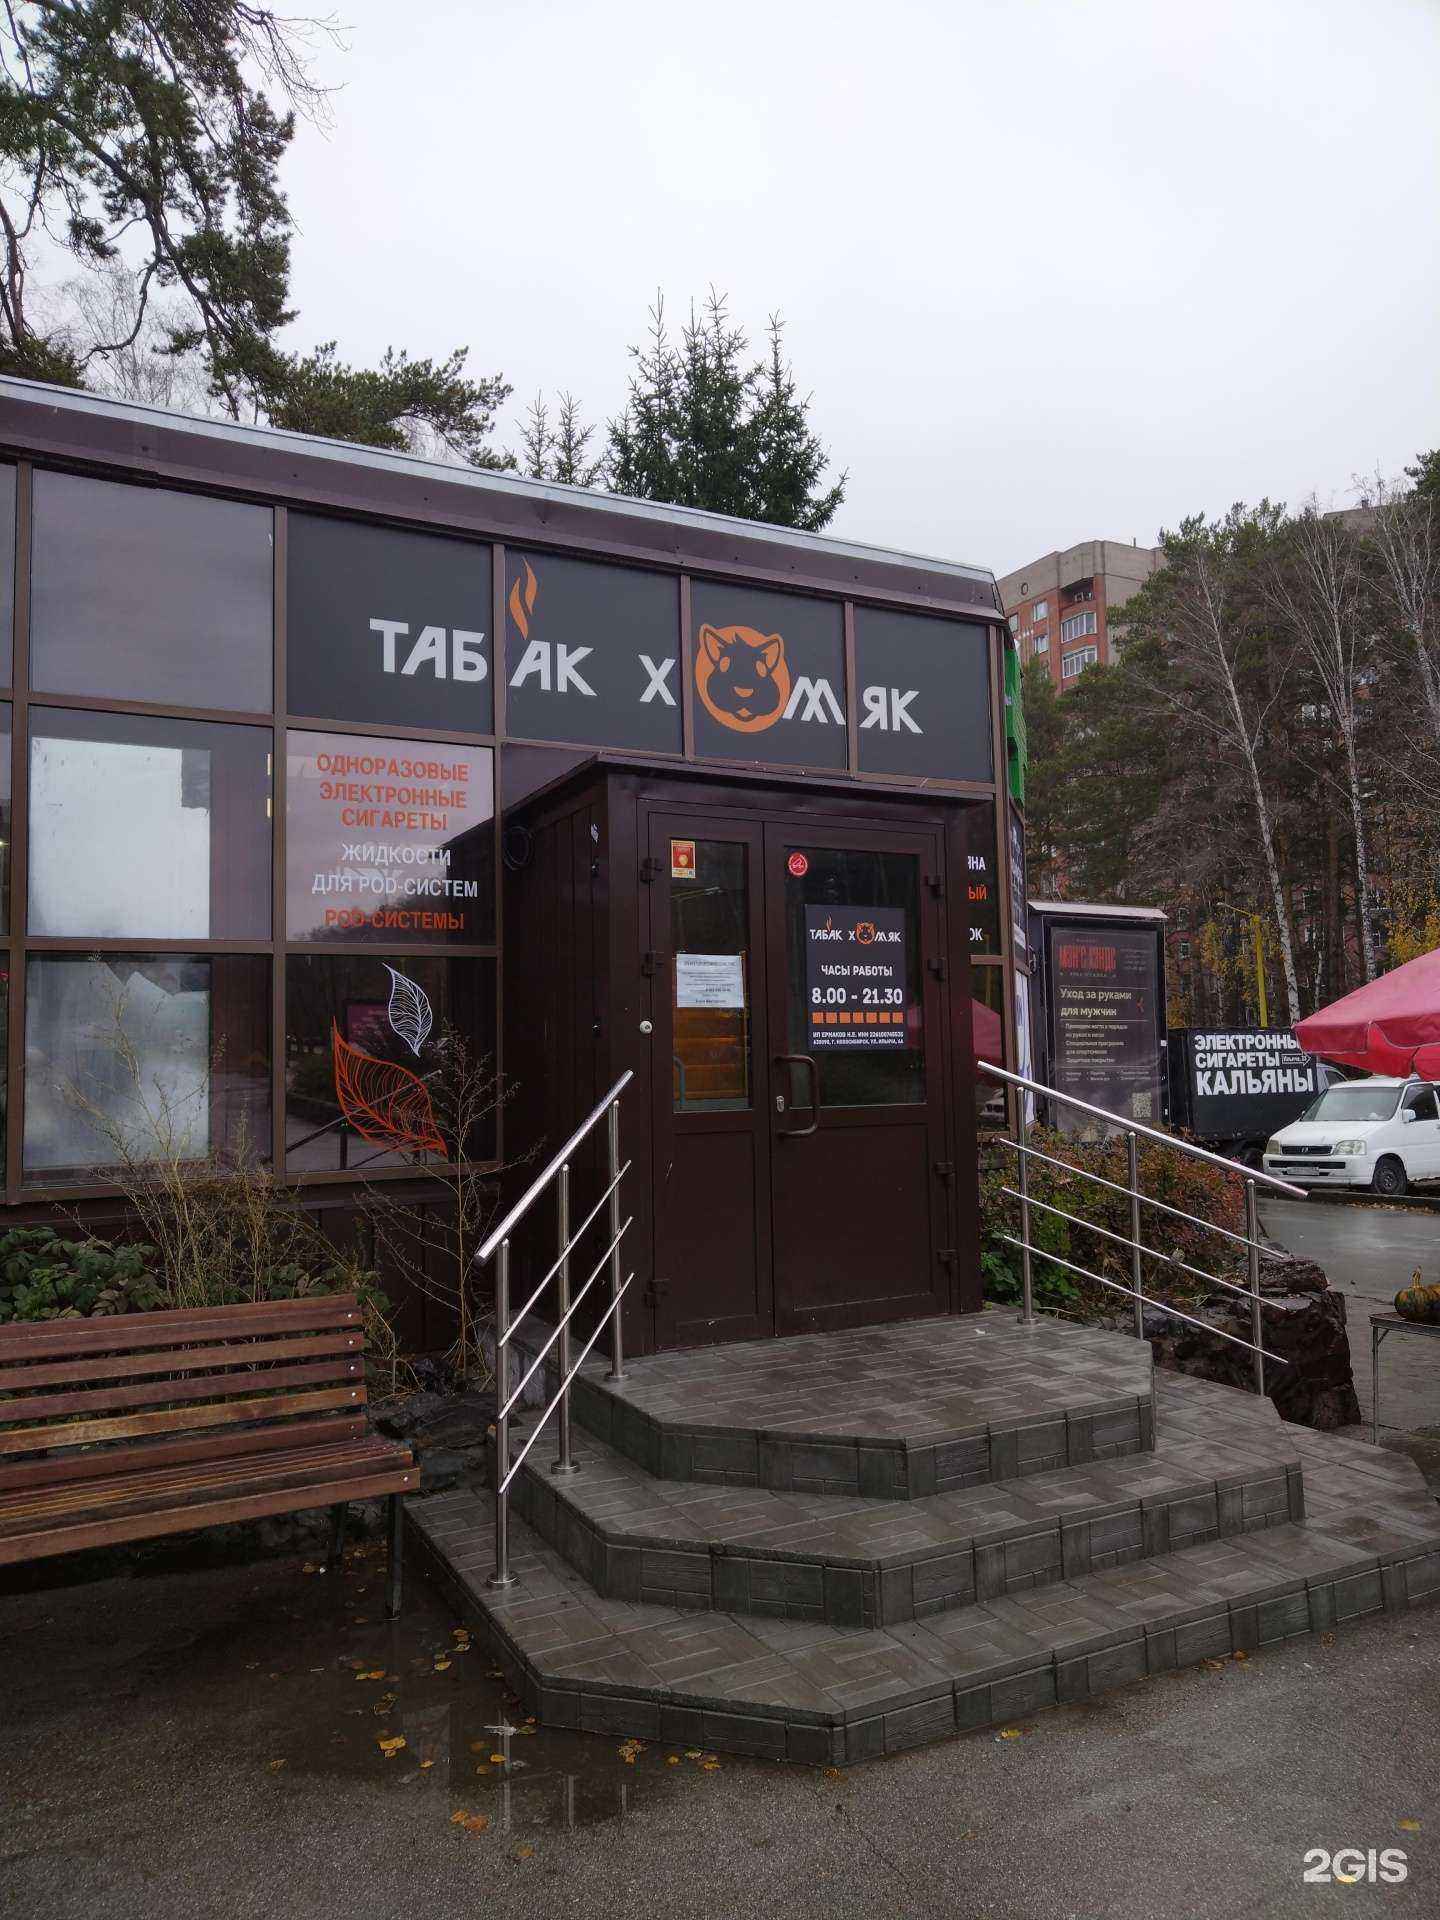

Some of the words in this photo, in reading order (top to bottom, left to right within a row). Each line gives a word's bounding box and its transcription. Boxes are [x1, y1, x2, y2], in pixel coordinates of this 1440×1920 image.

[370, 618, 598, 697] ТАБАК
[317, 753, 469, 782] ОДНОРАЗОВЫЕ
[319, 781, 467, 809] ЭЛЕКТРОННЫЕ
[341, 807, 448, 831] СИГАРЕТЫ
[341, 843, 451, 867] ЖИДКОСТИ
[312, 874, 353, 895] ДЛЯ
[359, 876, 478, 898] POD-СИСТЕМ
[325, 908, 465, 929] POD-СИСТЕМЫ
[809, 929, 843, 941] ТАБАК
[821, 964, 851, 976] ЧАСЫ
[852, 965, 893, 977] РАБОТЫ
[811, 987, 847, 1004] 8.00
[862, 988, 903, 1004] 21.30
[1060, 988, 1084, 1000] Уход
[1086, 991, 1097, 999] за
[1098, 991, 1132, 1002] руками
[1060, 1007, 1079, 1017] для
[1080, 1007, 1117, 1018] мужчин
[1194, 1034, 1301, 1051] ЭЛЕКТРОННЫ
[1195, 1051, 1280, 1068] СИГАРЕТЫ
[1196, 1068, 1314, 1096] КАЛЬЯНЫ
